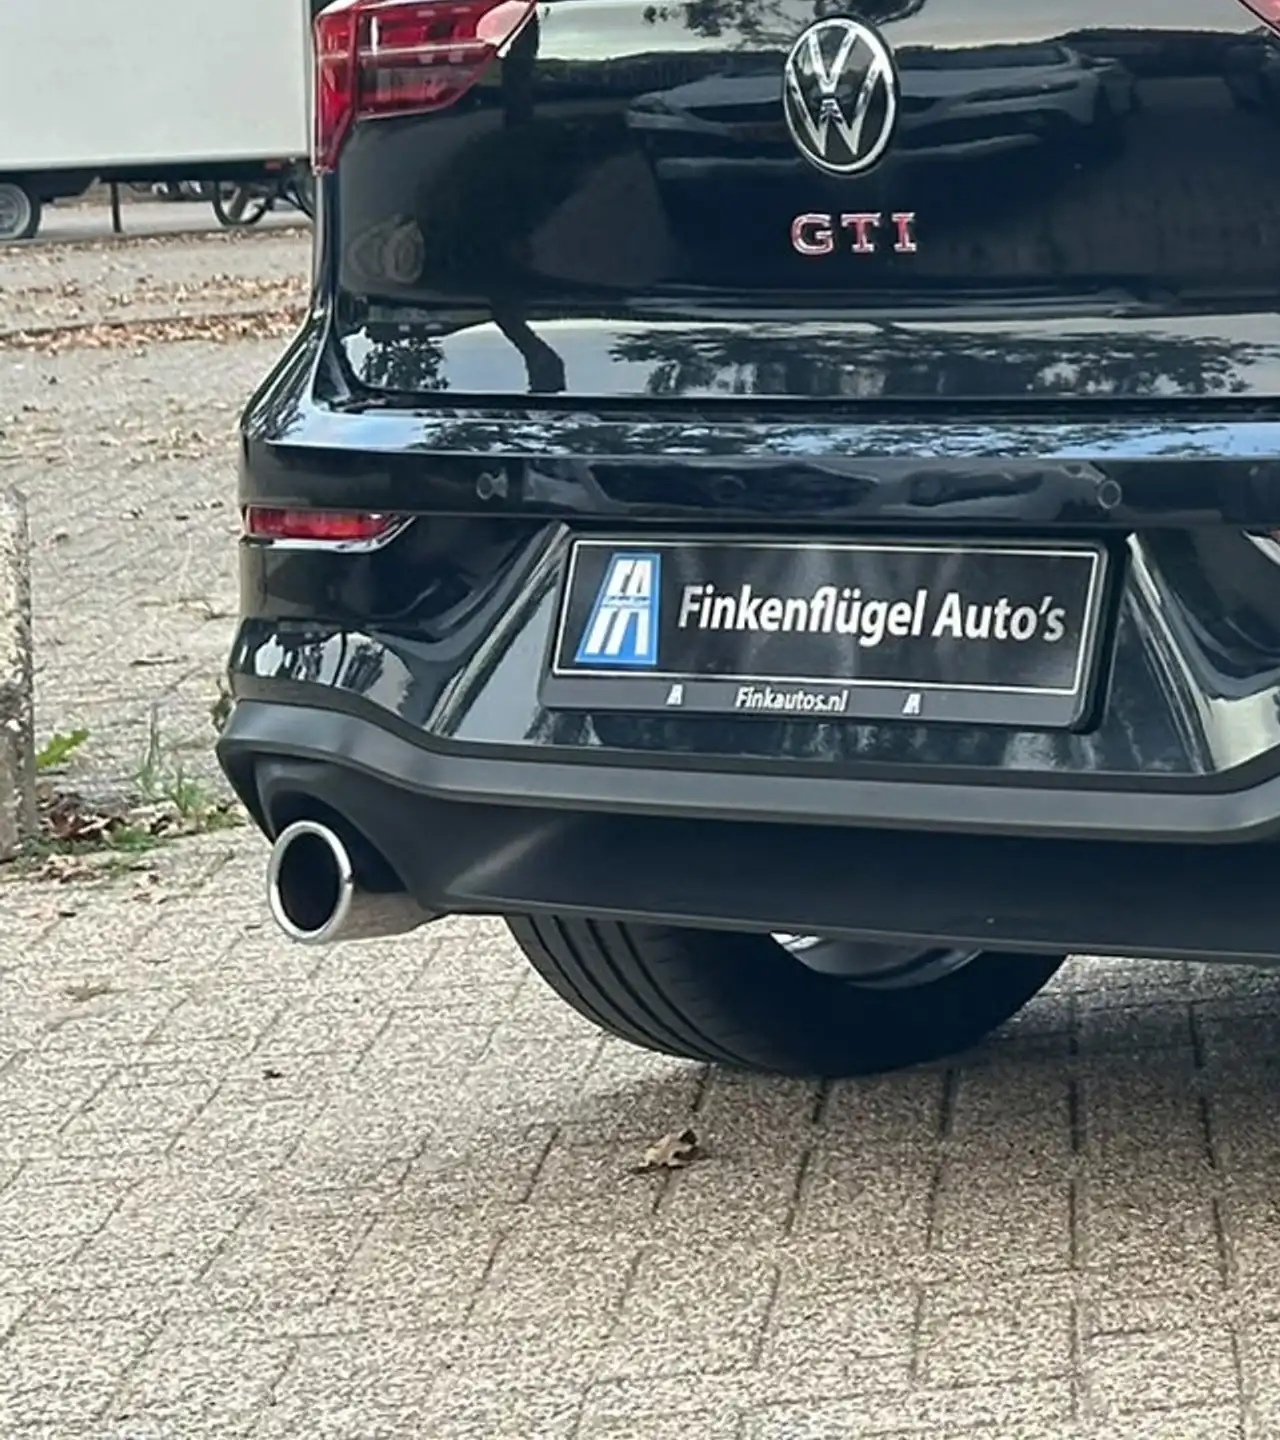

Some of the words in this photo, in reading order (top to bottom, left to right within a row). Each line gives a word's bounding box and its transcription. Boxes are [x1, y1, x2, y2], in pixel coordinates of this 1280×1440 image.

[791, 212, 916, 255] GTI
[678, 584, 927, 648] Finkenflügel
[933, 592, 1066, 642] Auto's
[735, 685, 849, 712] Finkautos.nl
